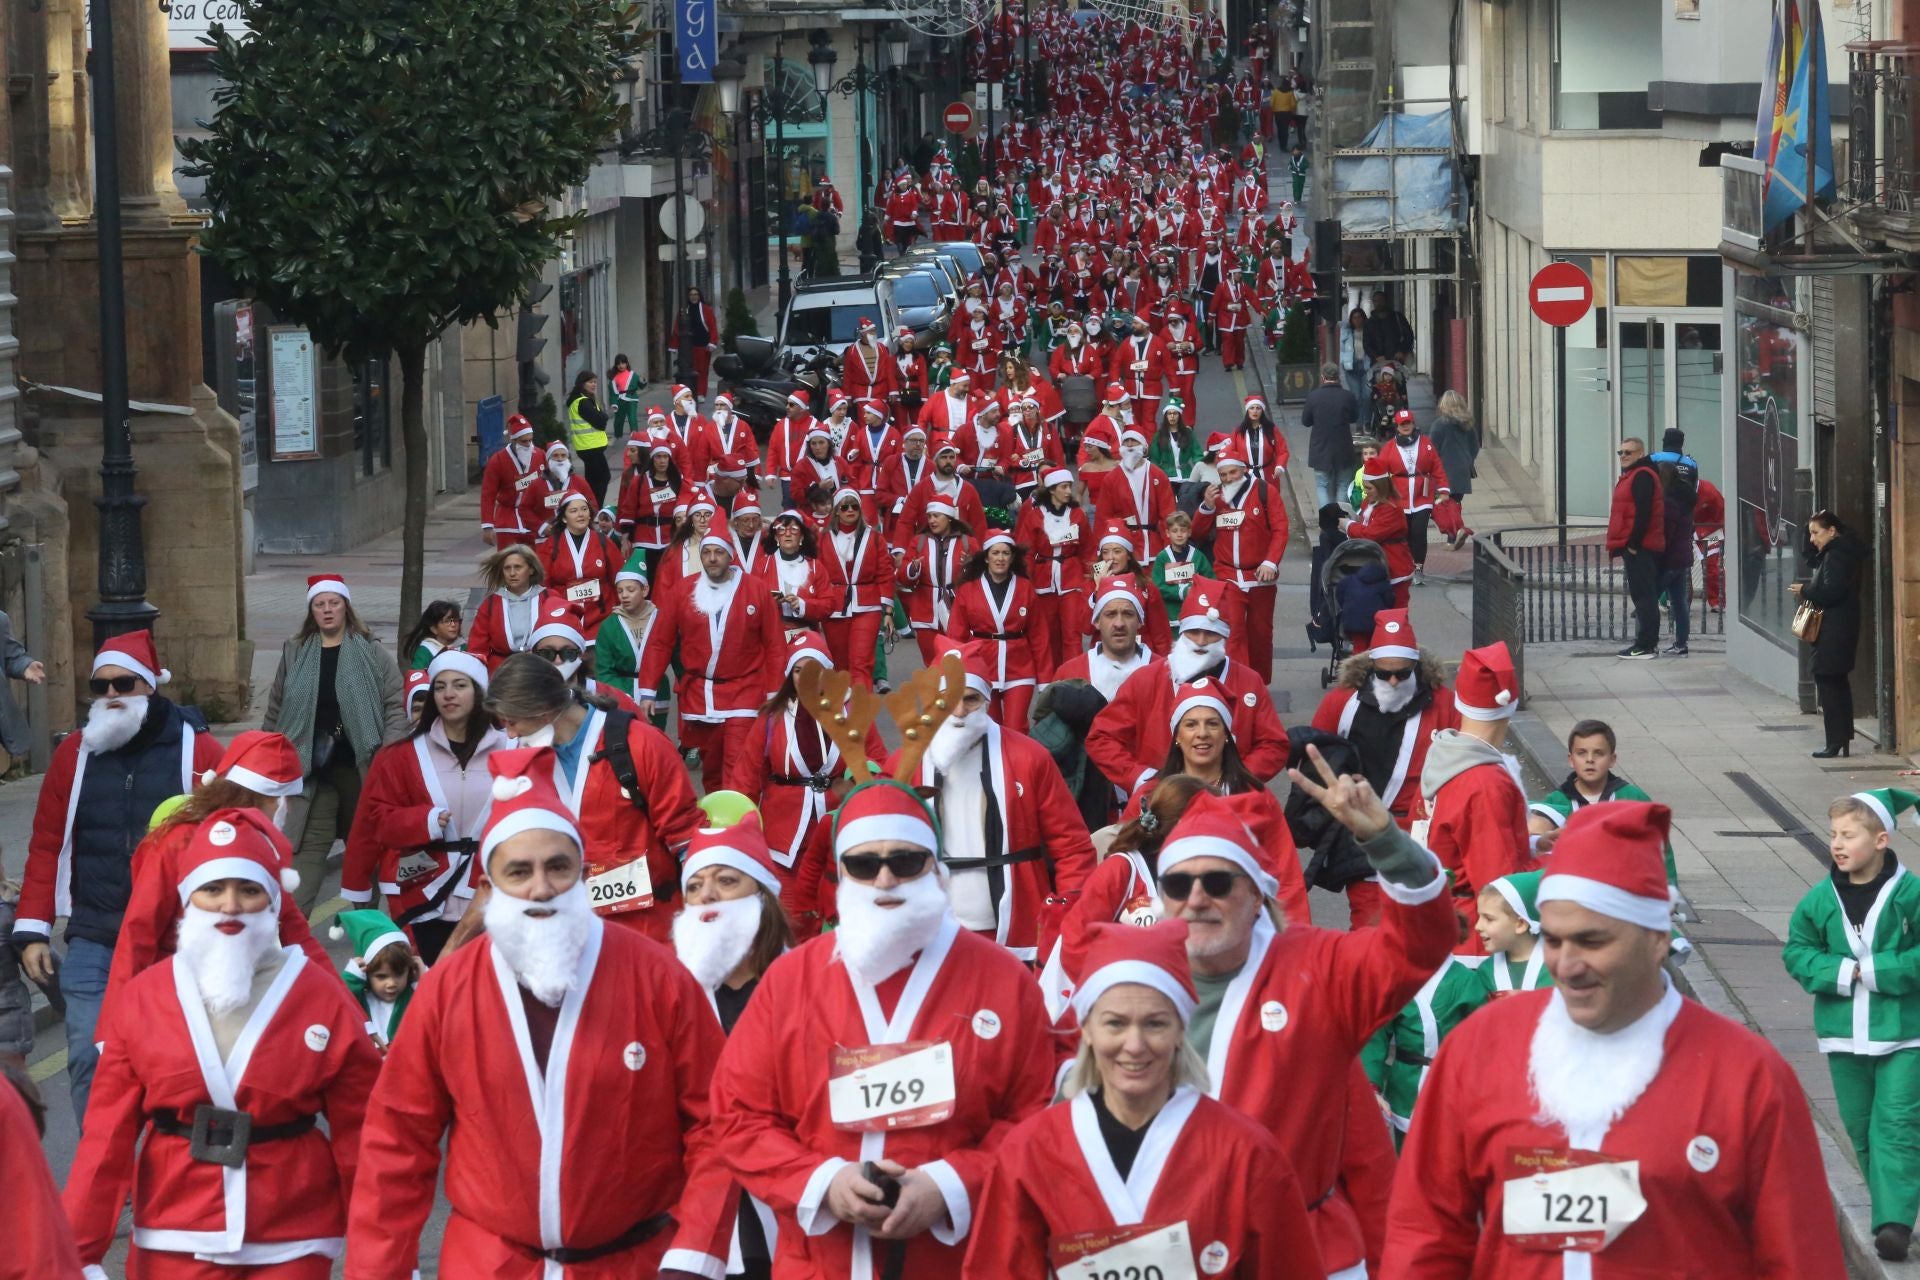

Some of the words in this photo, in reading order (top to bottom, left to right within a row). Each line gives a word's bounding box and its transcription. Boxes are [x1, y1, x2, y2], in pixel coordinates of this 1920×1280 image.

[1222, 517, 1238, 525] 1940
[575, 589, 593, 597] 1335
[591, 881, 637, 901] 2036
[860, 1078, 925, 1108] 1769
[1542, 1193, 1608, 1224] 1221
